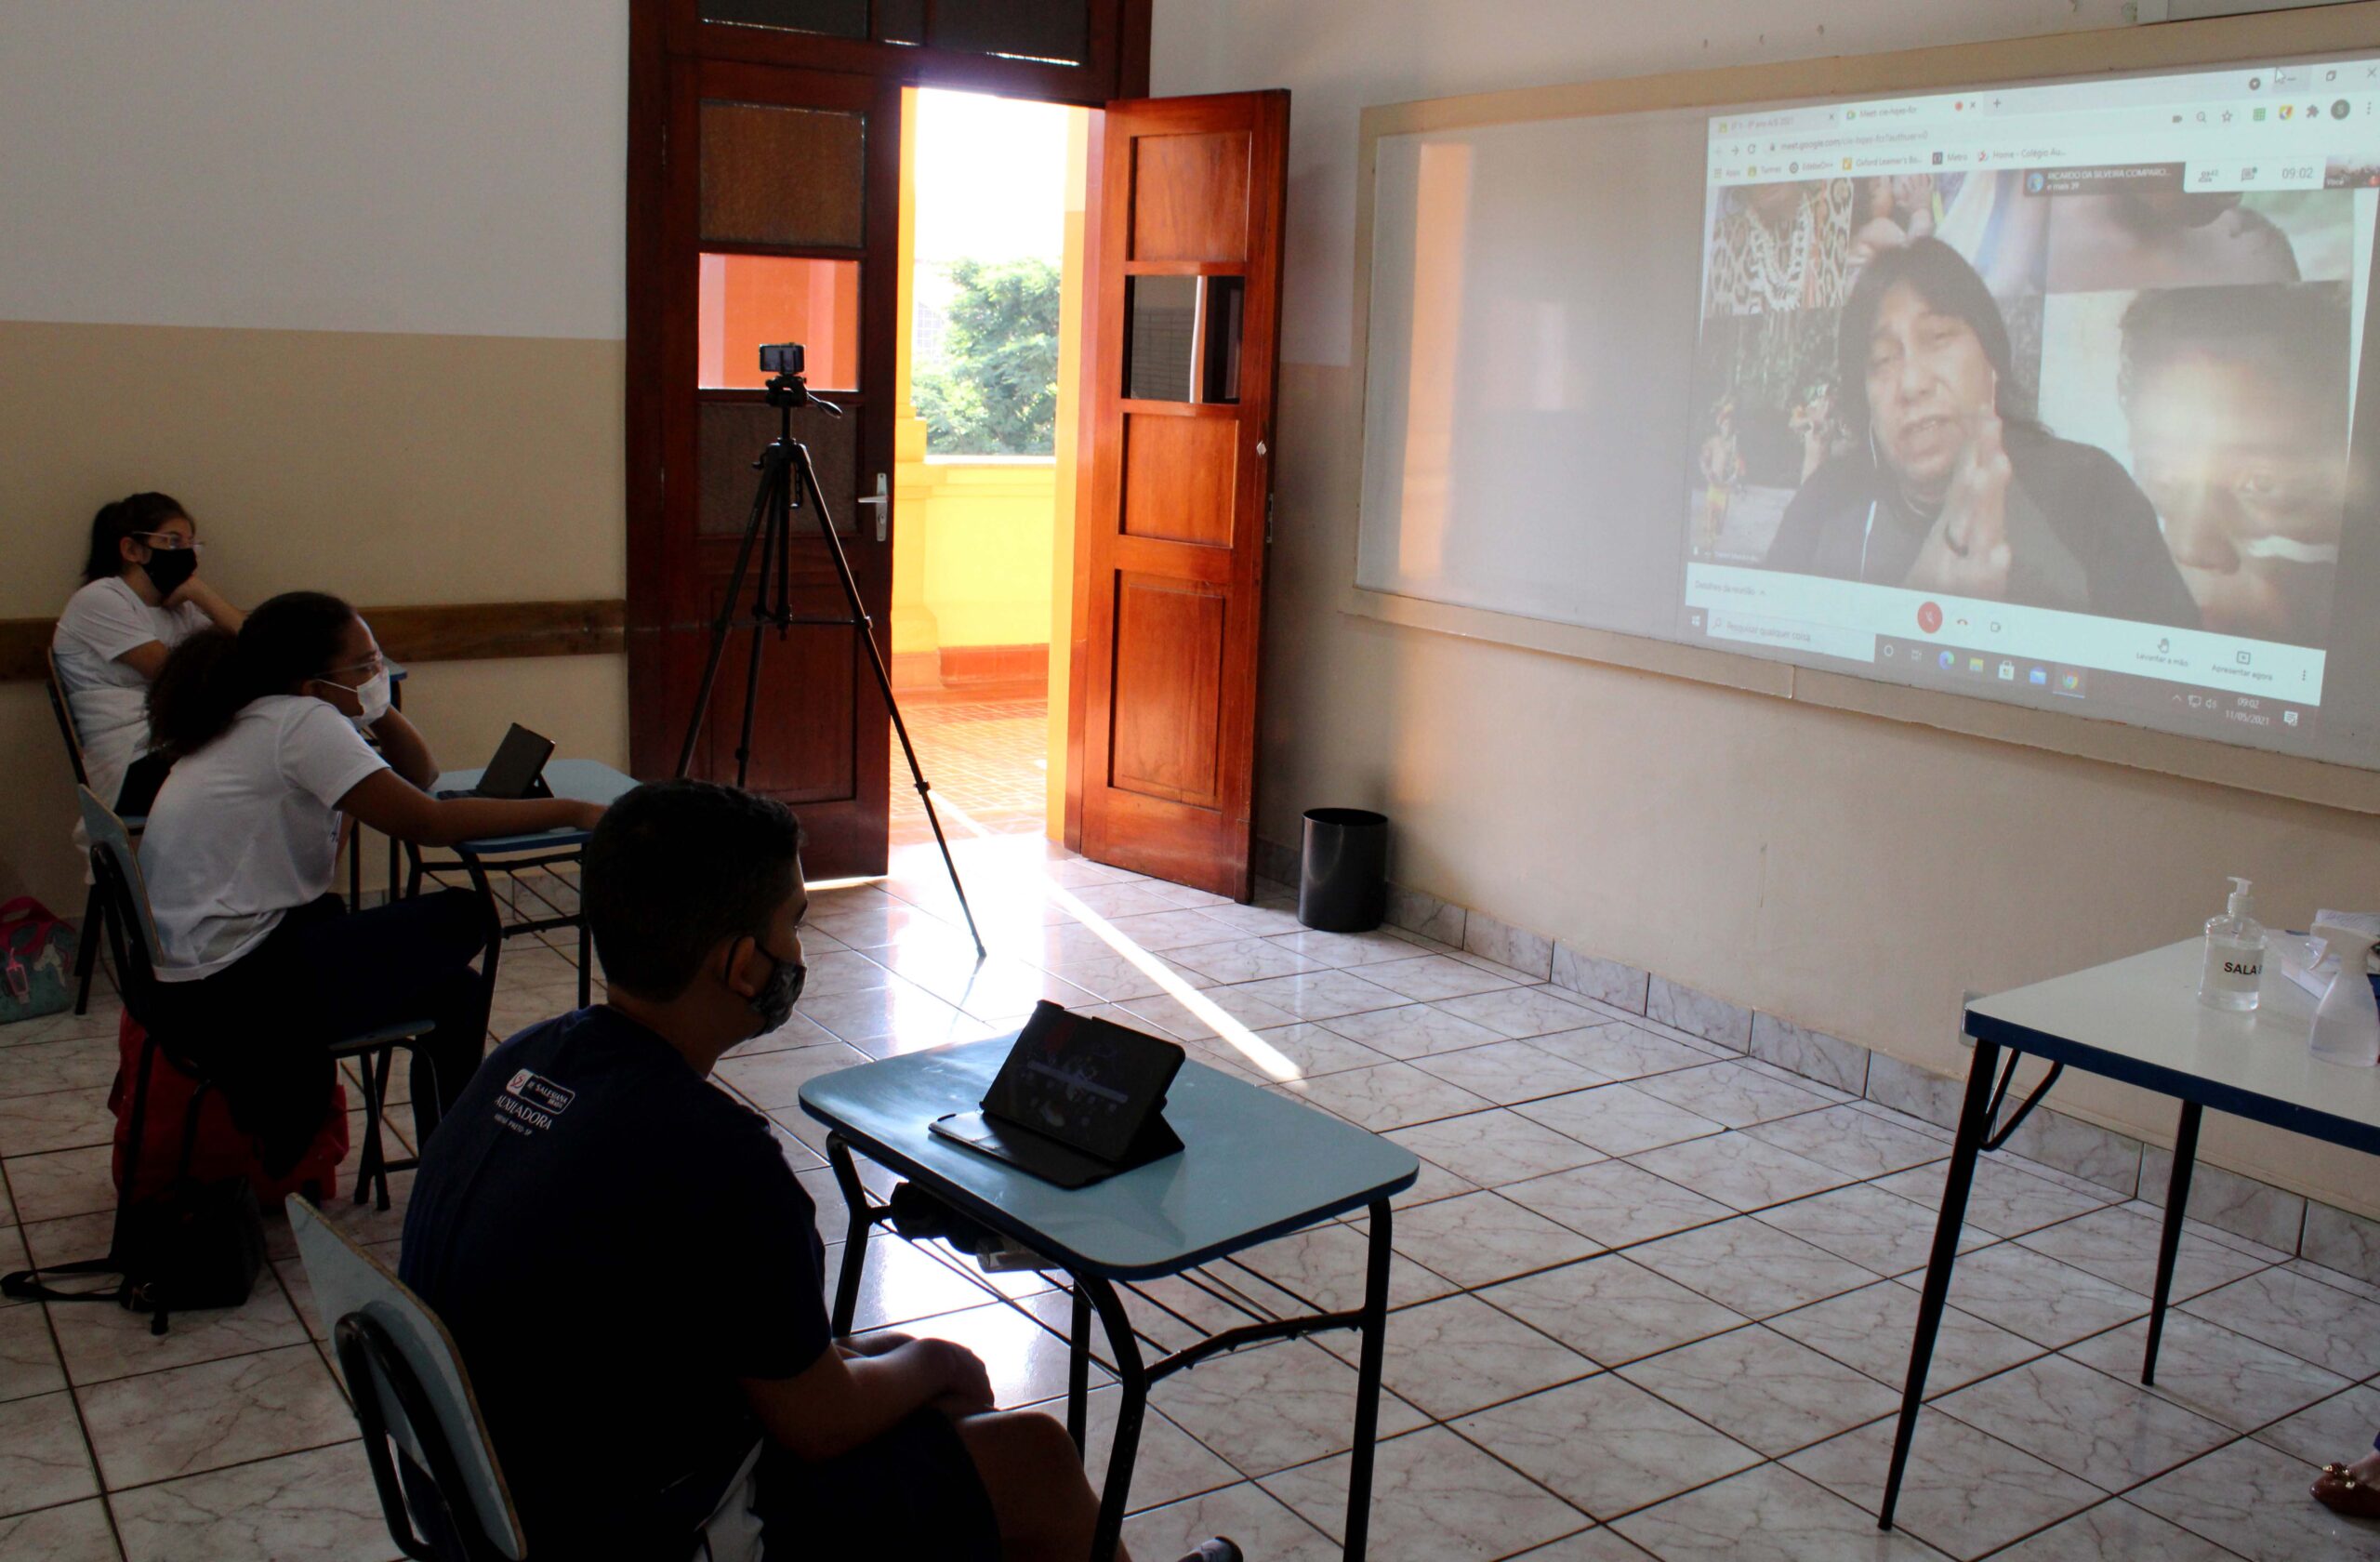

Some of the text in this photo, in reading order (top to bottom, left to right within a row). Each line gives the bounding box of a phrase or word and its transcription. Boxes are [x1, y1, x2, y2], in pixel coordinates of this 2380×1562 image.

[1992, 150, 2016, 160] Home
[2281, 165, 2314, 180] 09:02
[2135, 651, 2167, 664] Levantar
[2212, 663, 2274, 682] Apresentar agora
[2236, 696, 2260, 708] 09:02
[2225, 708, 2270, 726] 11/05/2021
